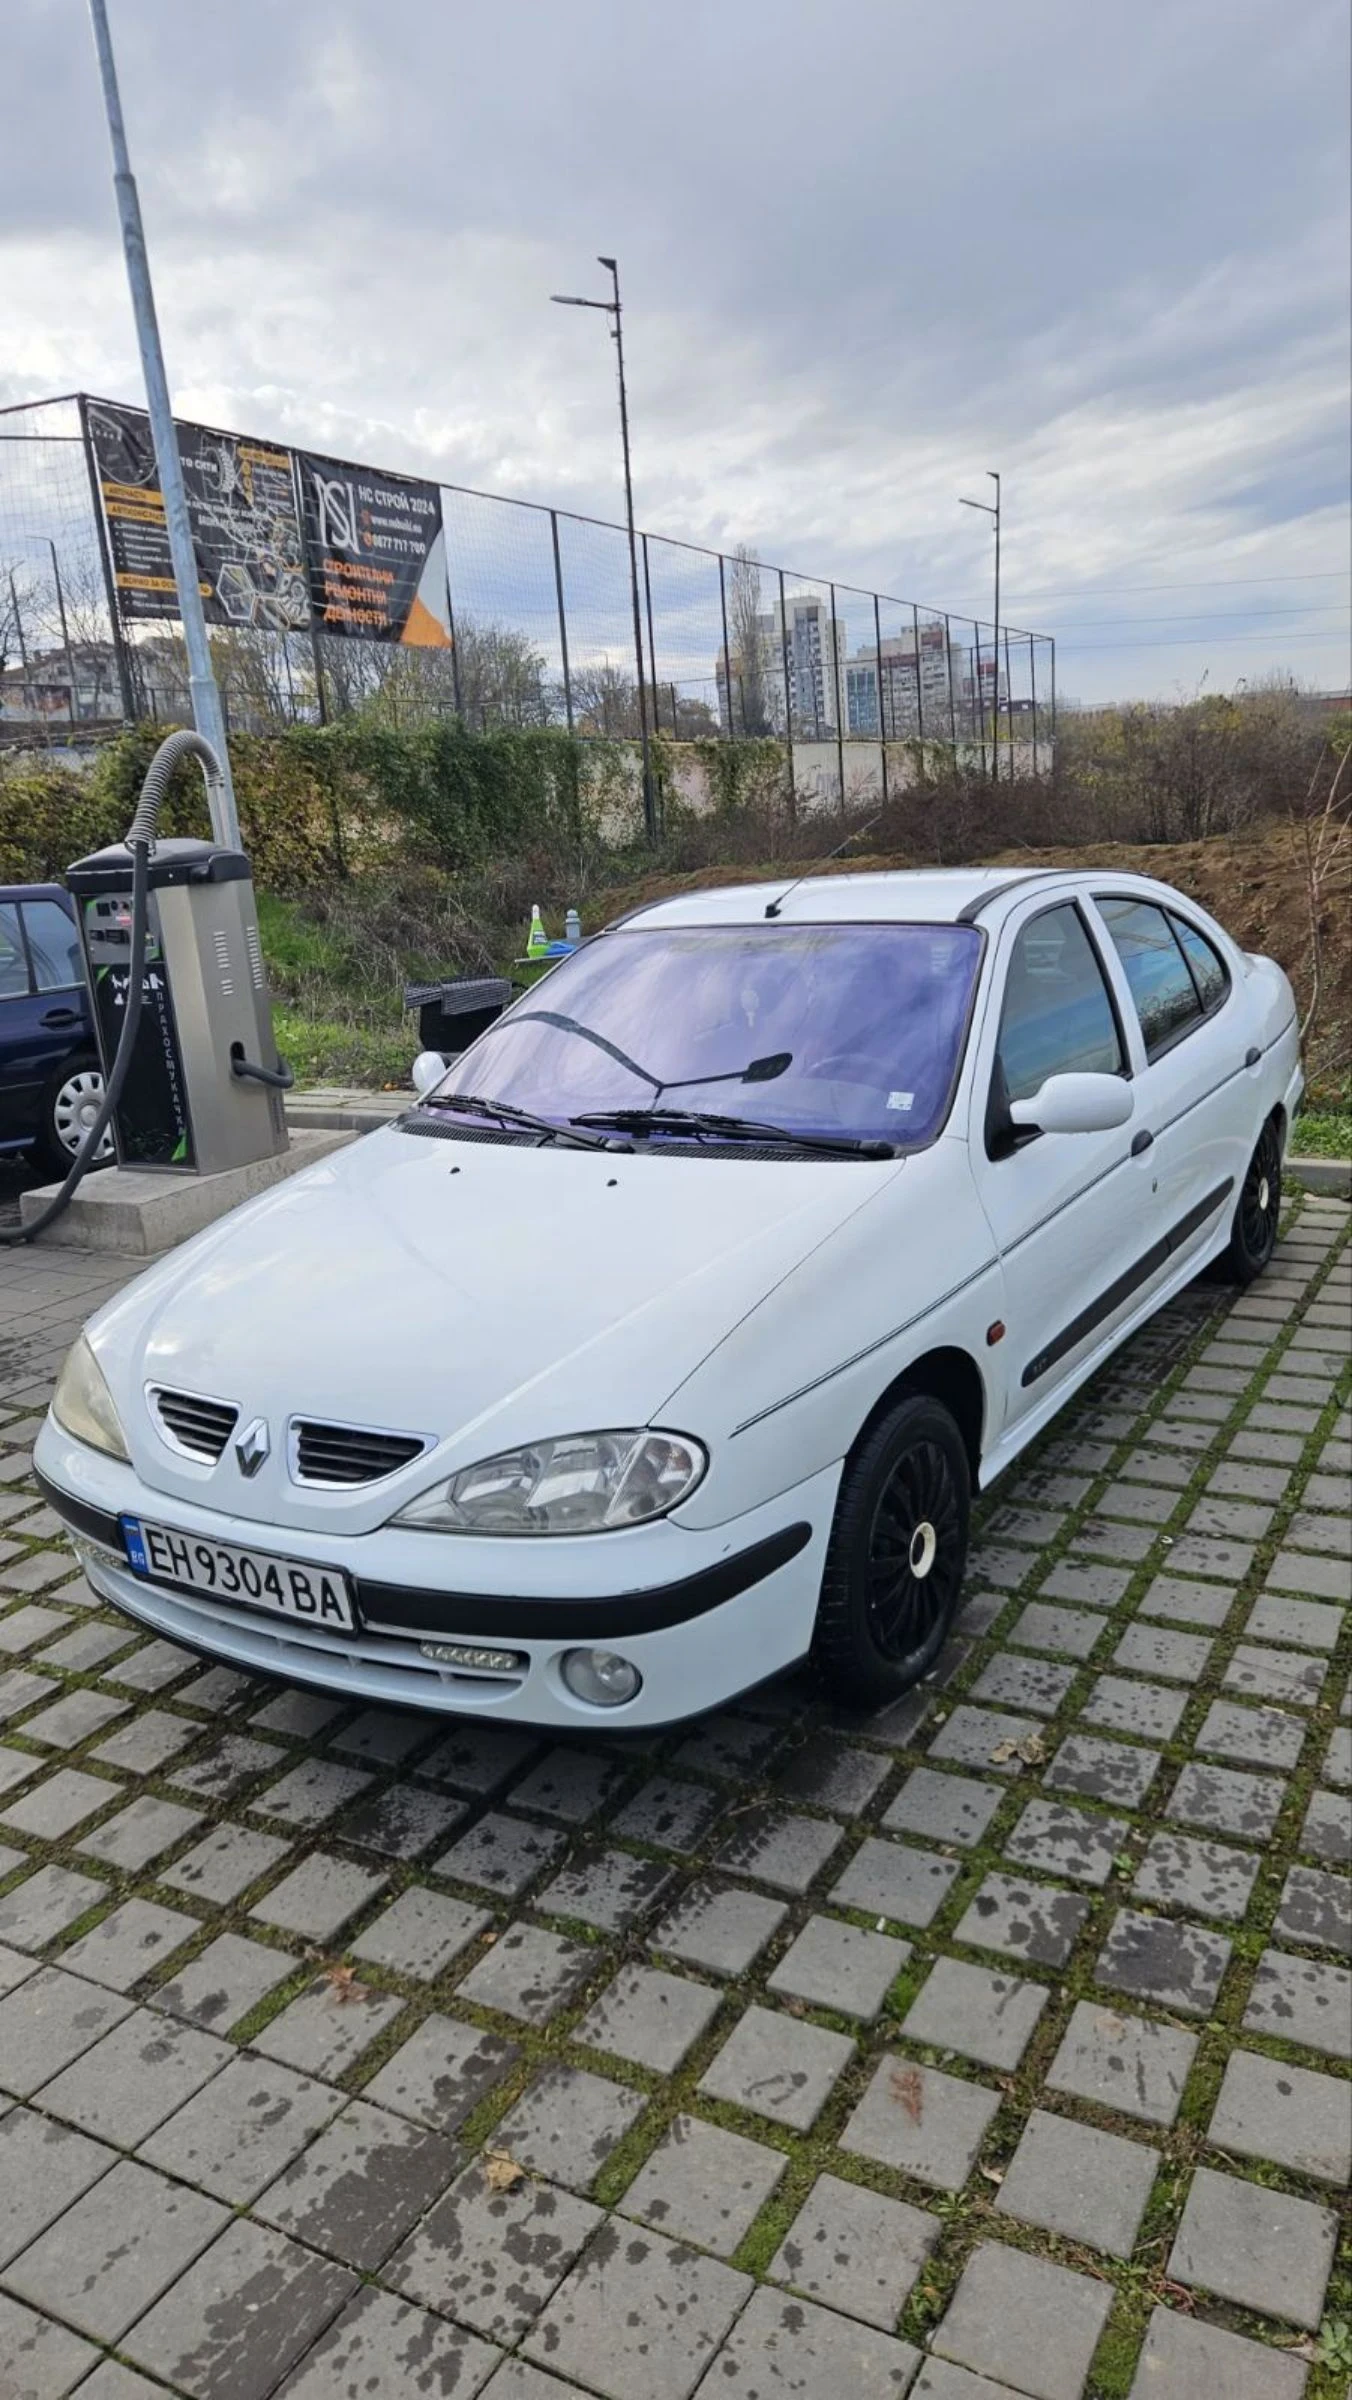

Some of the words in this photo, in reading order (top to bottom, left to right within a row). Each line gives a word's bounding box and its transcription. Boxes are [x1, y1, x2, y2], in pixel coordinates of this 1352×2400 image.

[358, 485, 373, 502] НС
[374, 489, 410, 511] СТРОЙ
[409, 496, 436, 515] 2024
[131, 1551, 145, 1565] BG
[145, 1528, 345, 1622] EH9304BA
